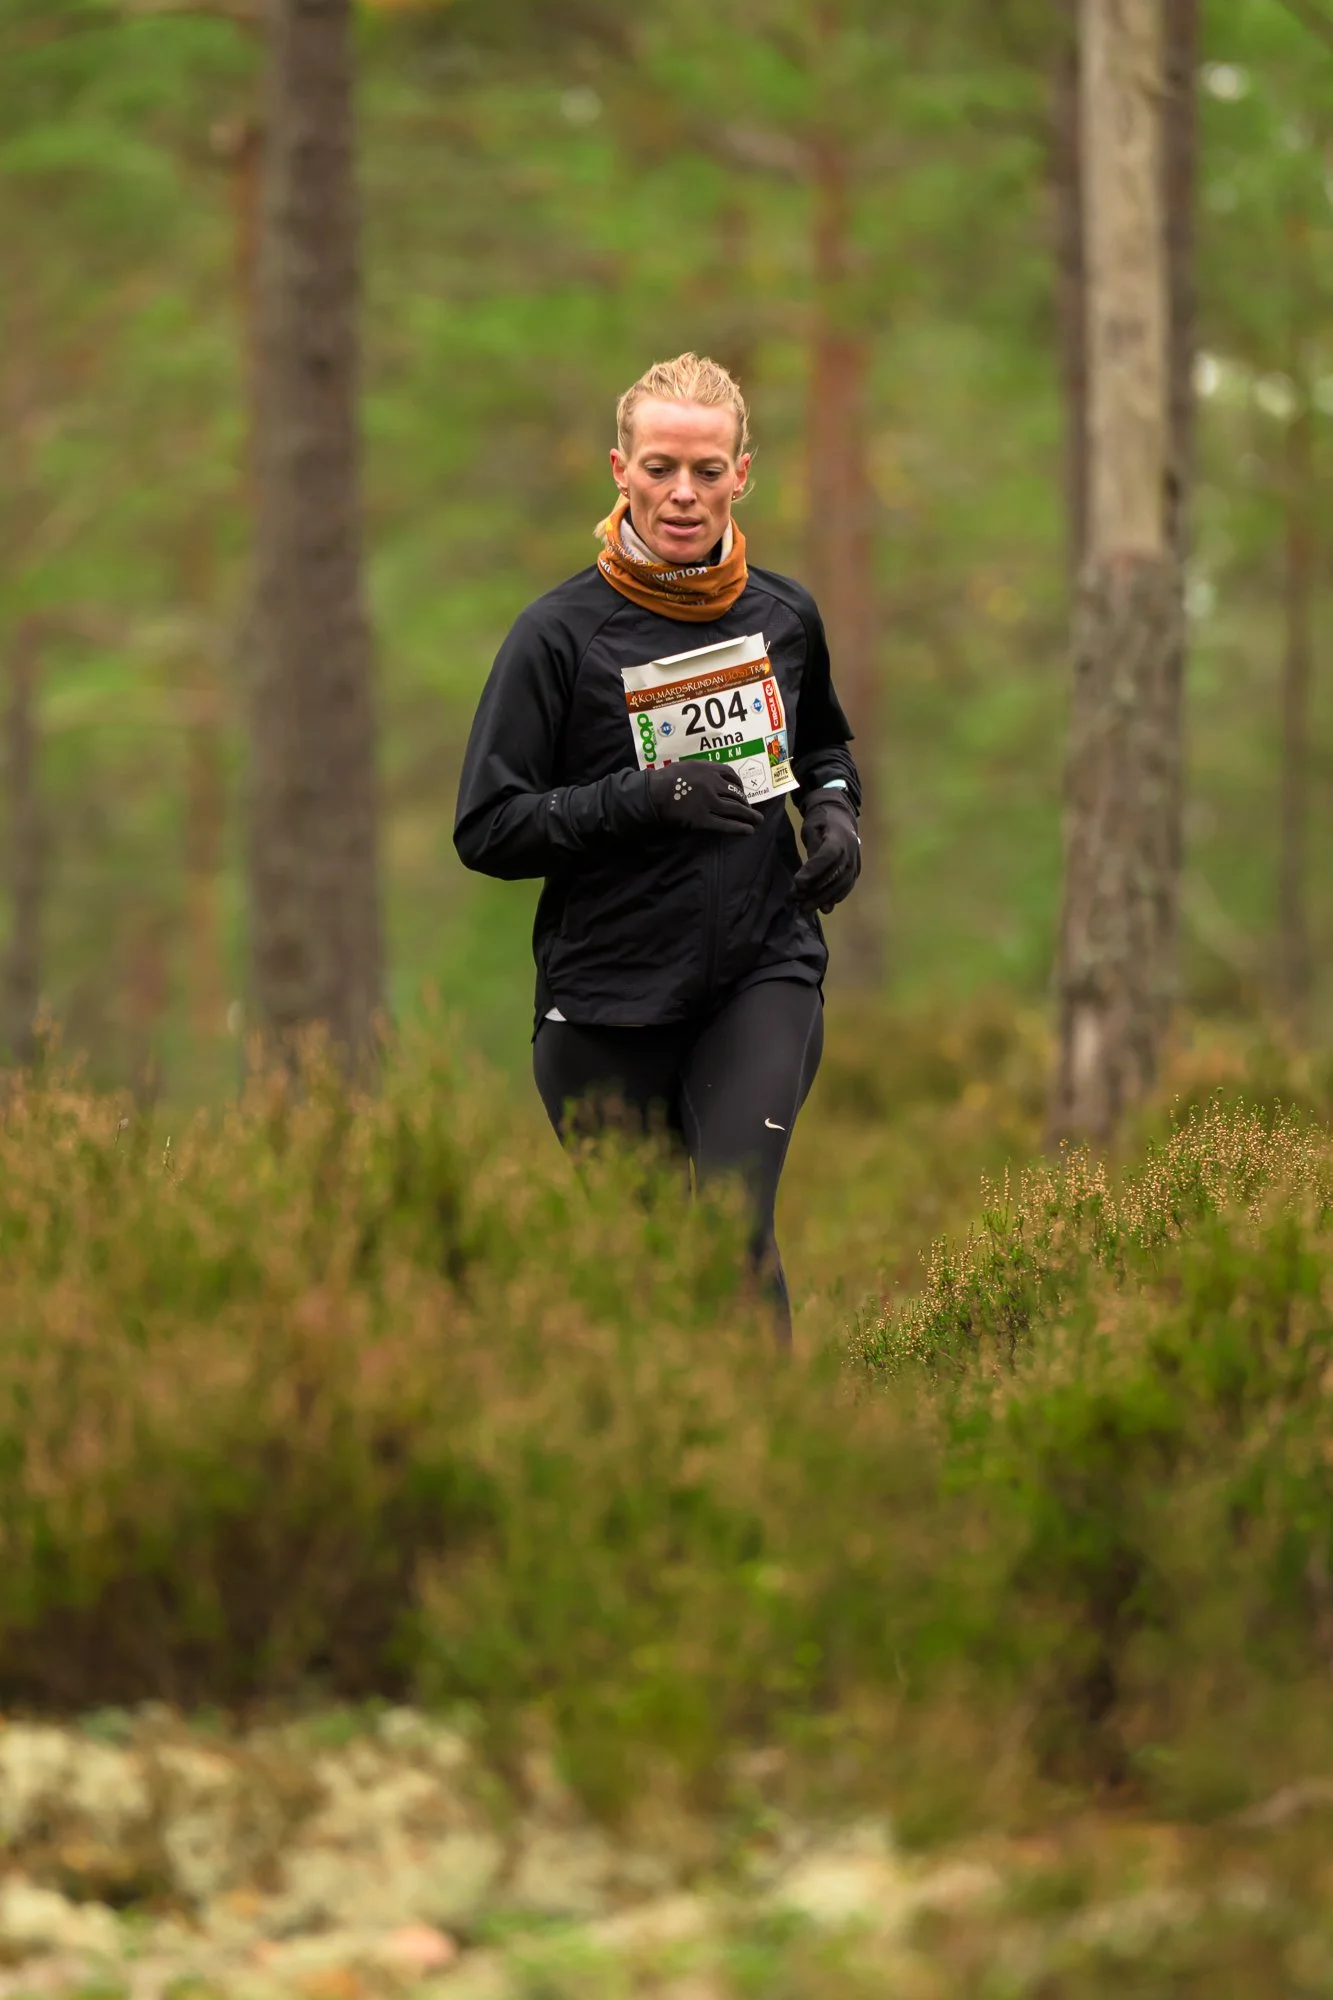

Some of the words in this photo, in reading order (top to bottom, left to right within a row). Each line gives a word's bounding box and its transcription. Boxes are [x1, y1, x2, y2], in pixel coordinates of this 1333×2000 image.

[681, 691, 747, 736] 204
[768, 697, 779, 727] CIRCLE
[637, 713, 657, 762] coop
[700, 731, 743, 751] Anna
[708, 750, 720, 762] 10
[728, 746, 742, 759] KM
